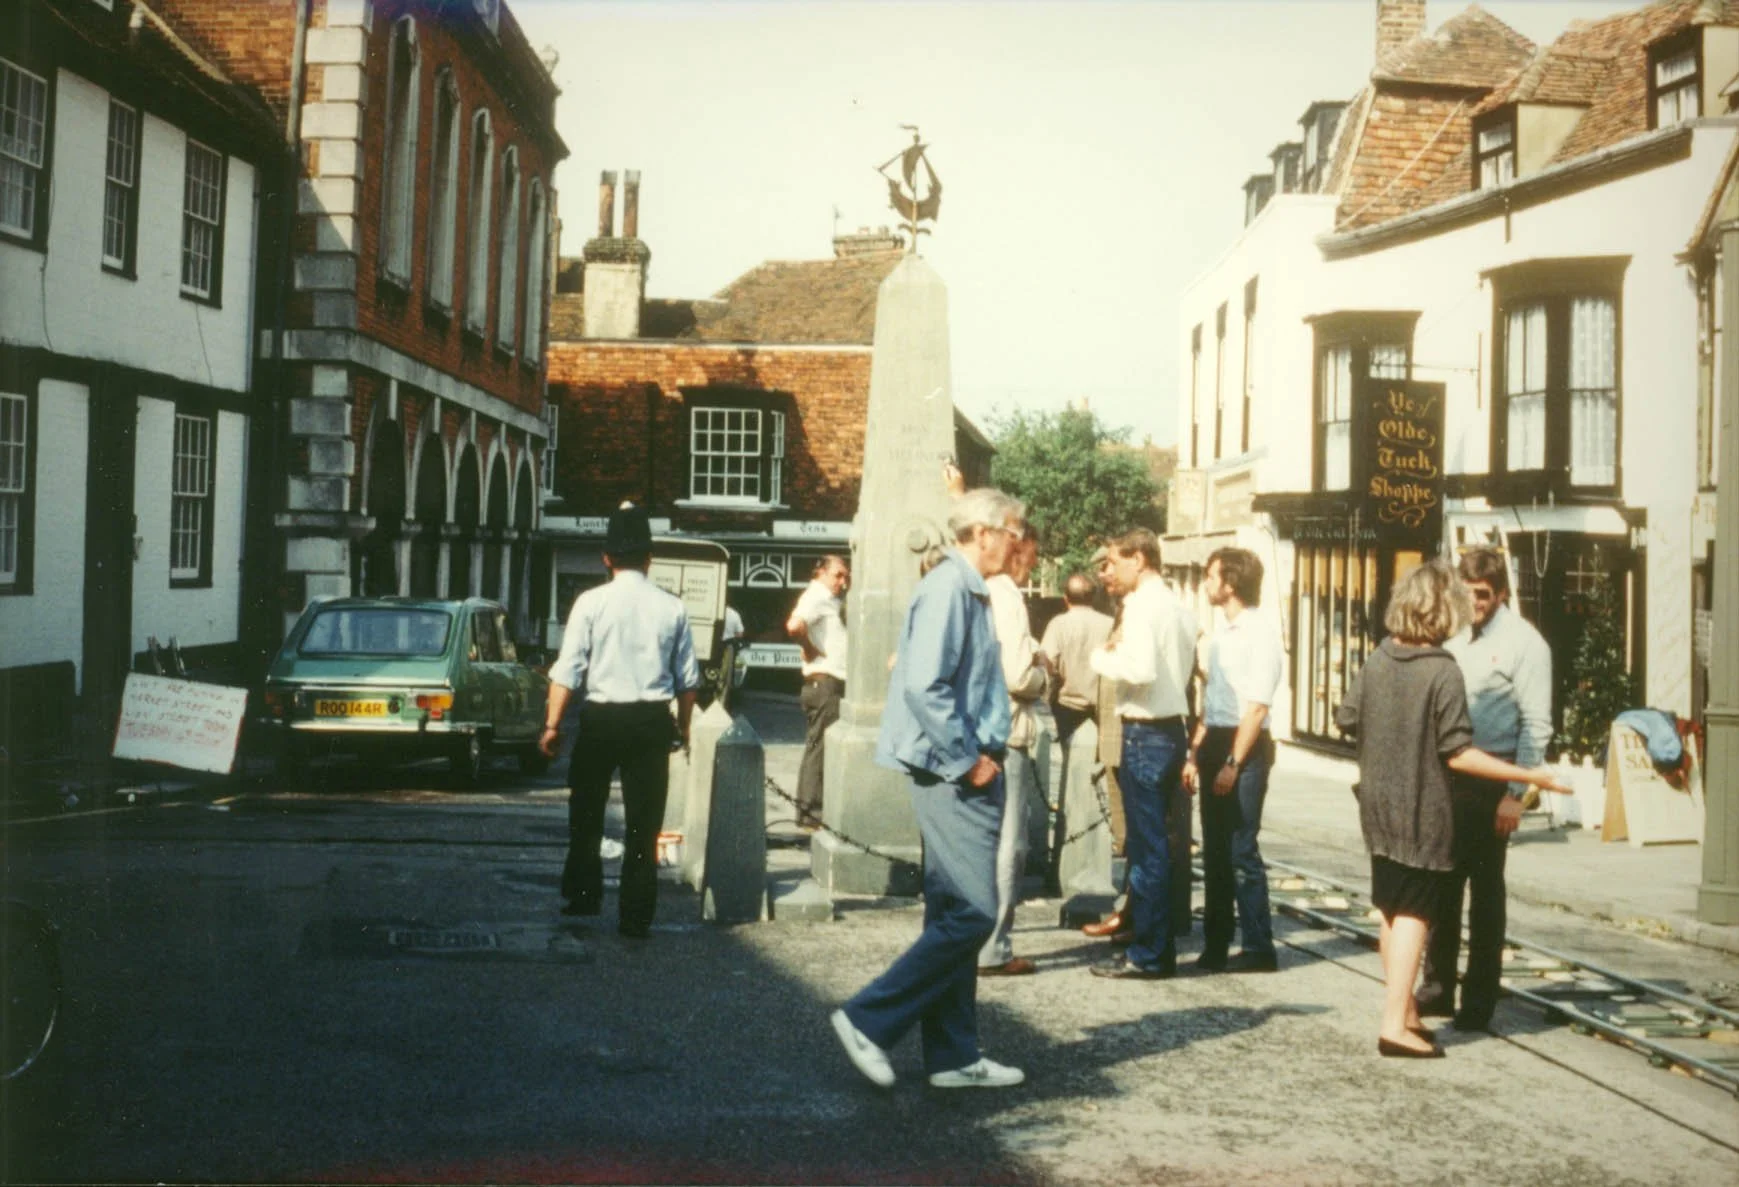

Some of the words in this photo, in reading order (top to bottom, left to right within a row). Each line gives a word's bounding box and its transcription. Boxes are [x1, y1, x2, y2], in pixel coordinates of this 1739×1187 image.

[1386, 389, 1418, 416] Ye
[1378, 419, 1431, 443] Olde
[1377, 448, 1434, 471] Tuck
[1368, 476, 1433, 504] Shoppe
[799, 521, 828, 534] Teas
[774, 649, 802, 665] Piem
